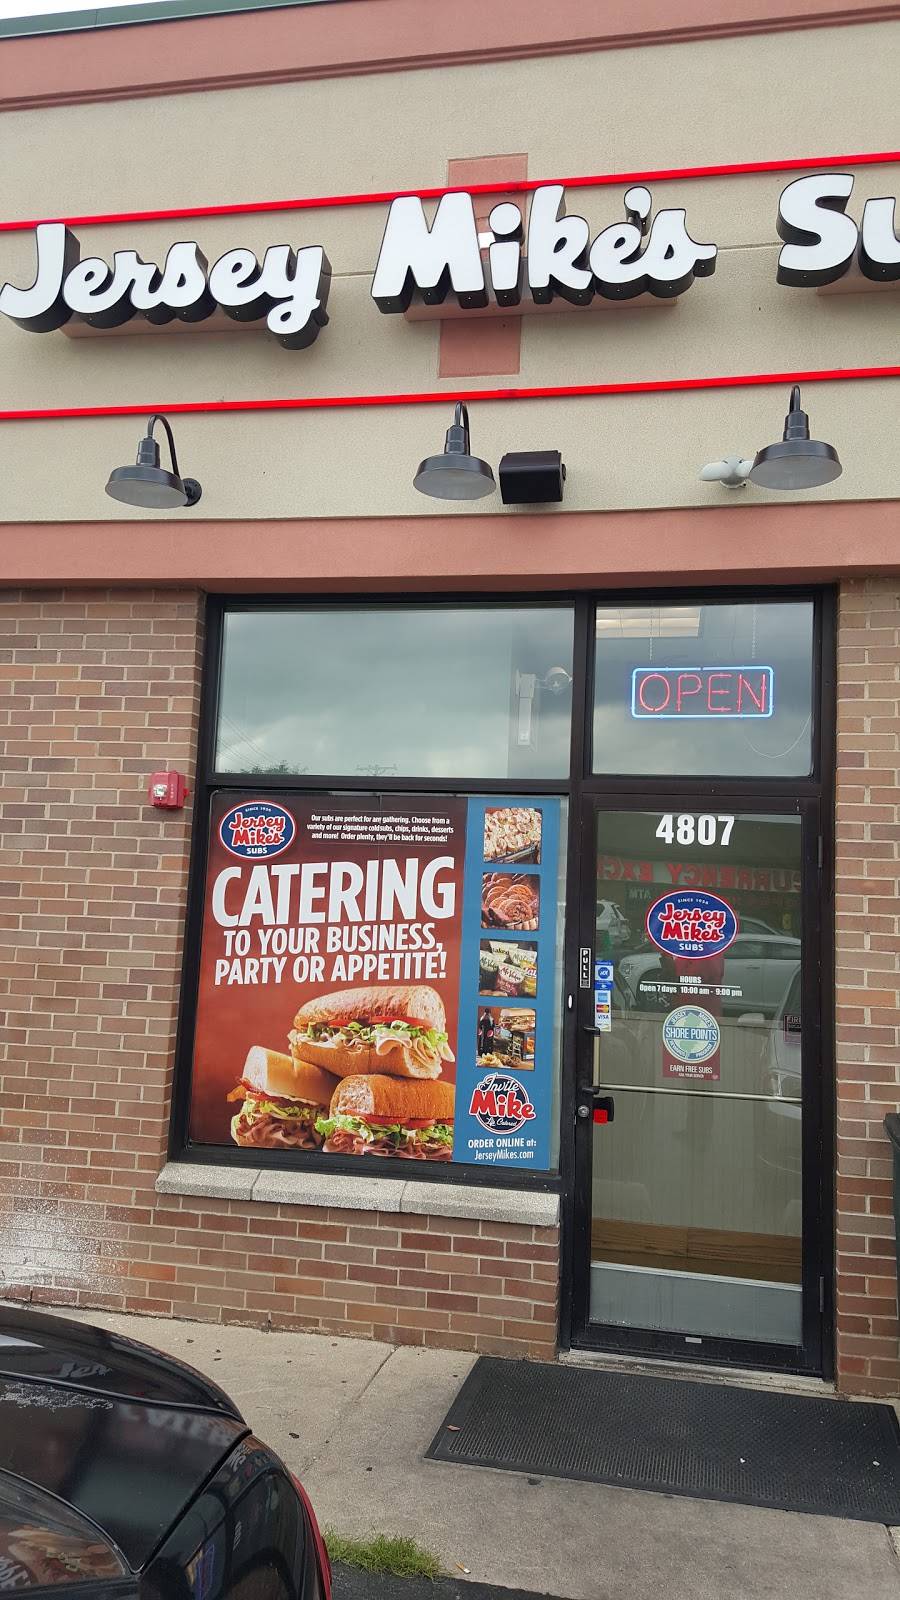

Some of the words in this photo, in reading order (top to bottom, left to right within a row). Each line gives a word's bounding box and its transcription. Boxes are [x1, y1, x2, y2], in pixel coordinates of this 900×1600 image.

[0, 222, 325, 335] Jersey
[371, 185, 718, 298] Mike's
[639, 673, 767, 713] OPEN
[229, 812, 286, 833] Jersey
[382, 816, 410, 824] gathering.
[655, 814, 735, 846] 4807
[232, 829, 285, 847] Mike's
[356, 832, 376, 841] plenty,
[211, 856, 456, 928] CATERING
[658, 902, 726, 929] Jersey
[224, 929, 251, 956] TO
[257, 927, 320, 955] YOUR
[326, 922, 443, 953] BUSINESS,
[661, 920, 725, 942] Mike's
[679, 943, 704, 951] SUBS
[214, 957, 288, 986] PARTY
[292, 954, 326, 982] OR
[330, 951, 448, 981] APPETITE!
[640, 984, 656, 992] Open
[662, 985, 677, 993] days
[665, 1027, 689, 1039] SHORE
[690, 1029, 718, 1041] POINTS
[669, 1064, 685, 1072] EARN
[477, 1072, 520, 1092] Invite
[469, 1088, 536, 1120] Mike
[468, 1139, 494, 1149] ORDER
[496, 1137, 525, 1148] ONLINE
[526, 1138, 537, 1147] at:
[474, 1149, 534, 1162] JerseyMikes.com
